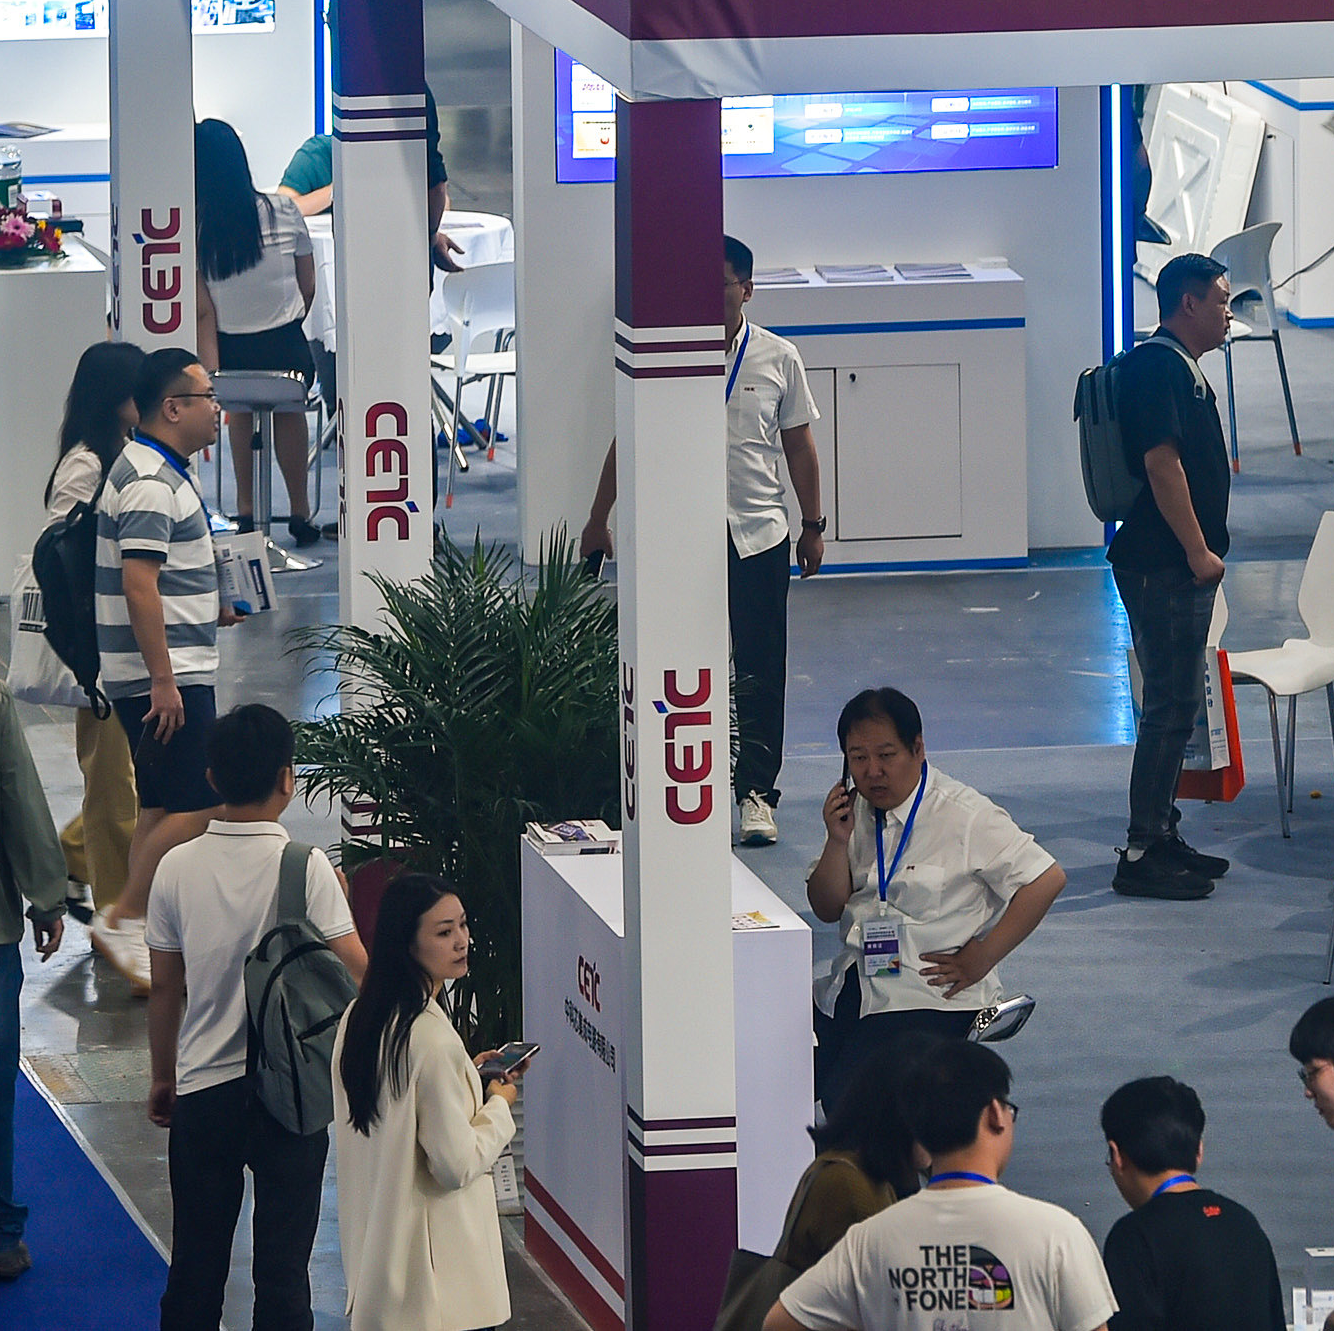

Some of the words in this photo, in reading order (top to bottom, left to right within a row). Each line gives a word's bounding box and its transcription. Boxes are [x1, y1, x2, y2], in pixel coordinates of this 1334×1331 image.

[135, 207, 182, 335] CETC
[365, 400, 415, 542] CETC
[655, 667, 713, 826] CETC
[578, 954, 601, 1014] CETC
[888, 1267, 968, 1289] NORTH
[920, 1245, 968, 1266] THE
[905, 1289, 968, 1312] FONE
